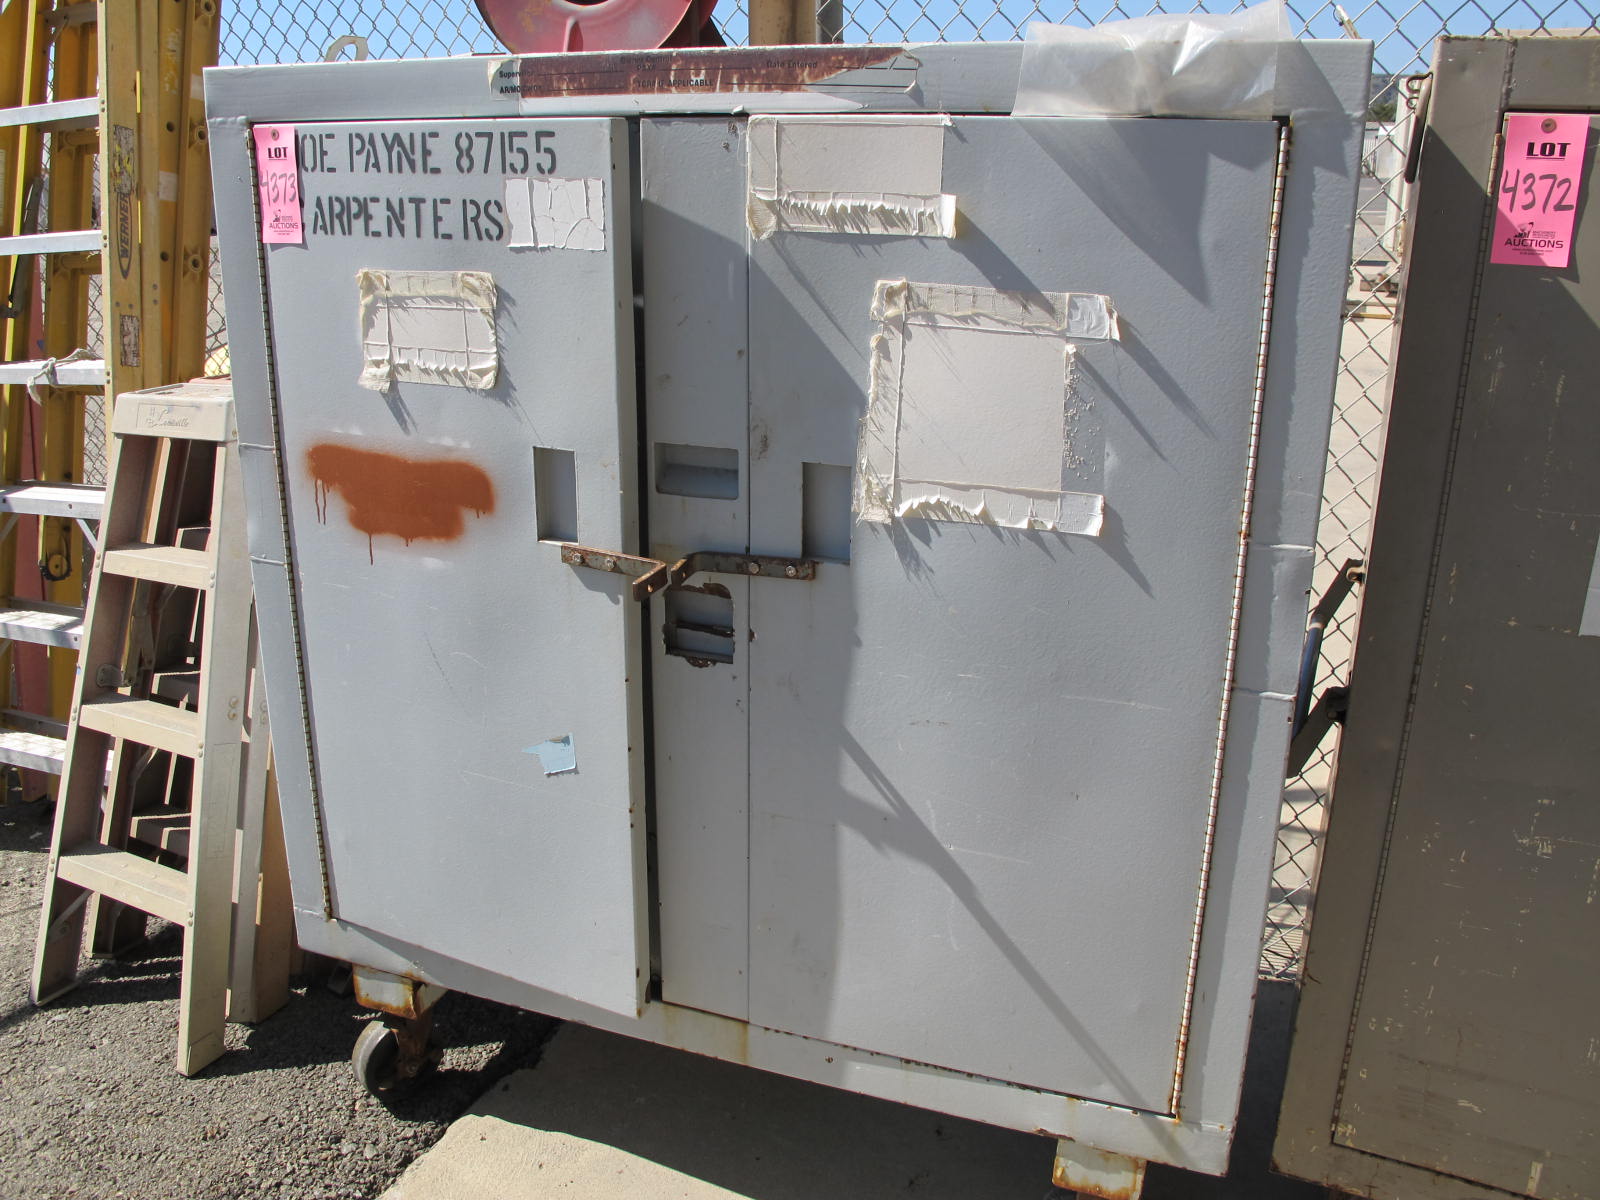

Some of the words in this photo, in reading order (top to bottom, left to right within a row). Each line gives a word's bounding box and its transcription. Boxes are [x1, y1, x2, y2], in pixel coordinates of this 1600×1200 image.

[267, 147, 288, 159] LOT
[297, 132, 337, 174] OE
[349, 132, 441, 174] PAYNE
[455, 131, 557, 175] 87155
[1526, 142, 1571, 157] LOT
[259, 169, 297, 206] 4373
[1502, 169, 1575, 214] 4372
[119, 192, 129, 258] WERNER
[268, 222, 299, 230] AUCTIONS
[300, 196, 503, 241] ARPENTERS
[1504, 238, 1564, 249] AUCTIONS
